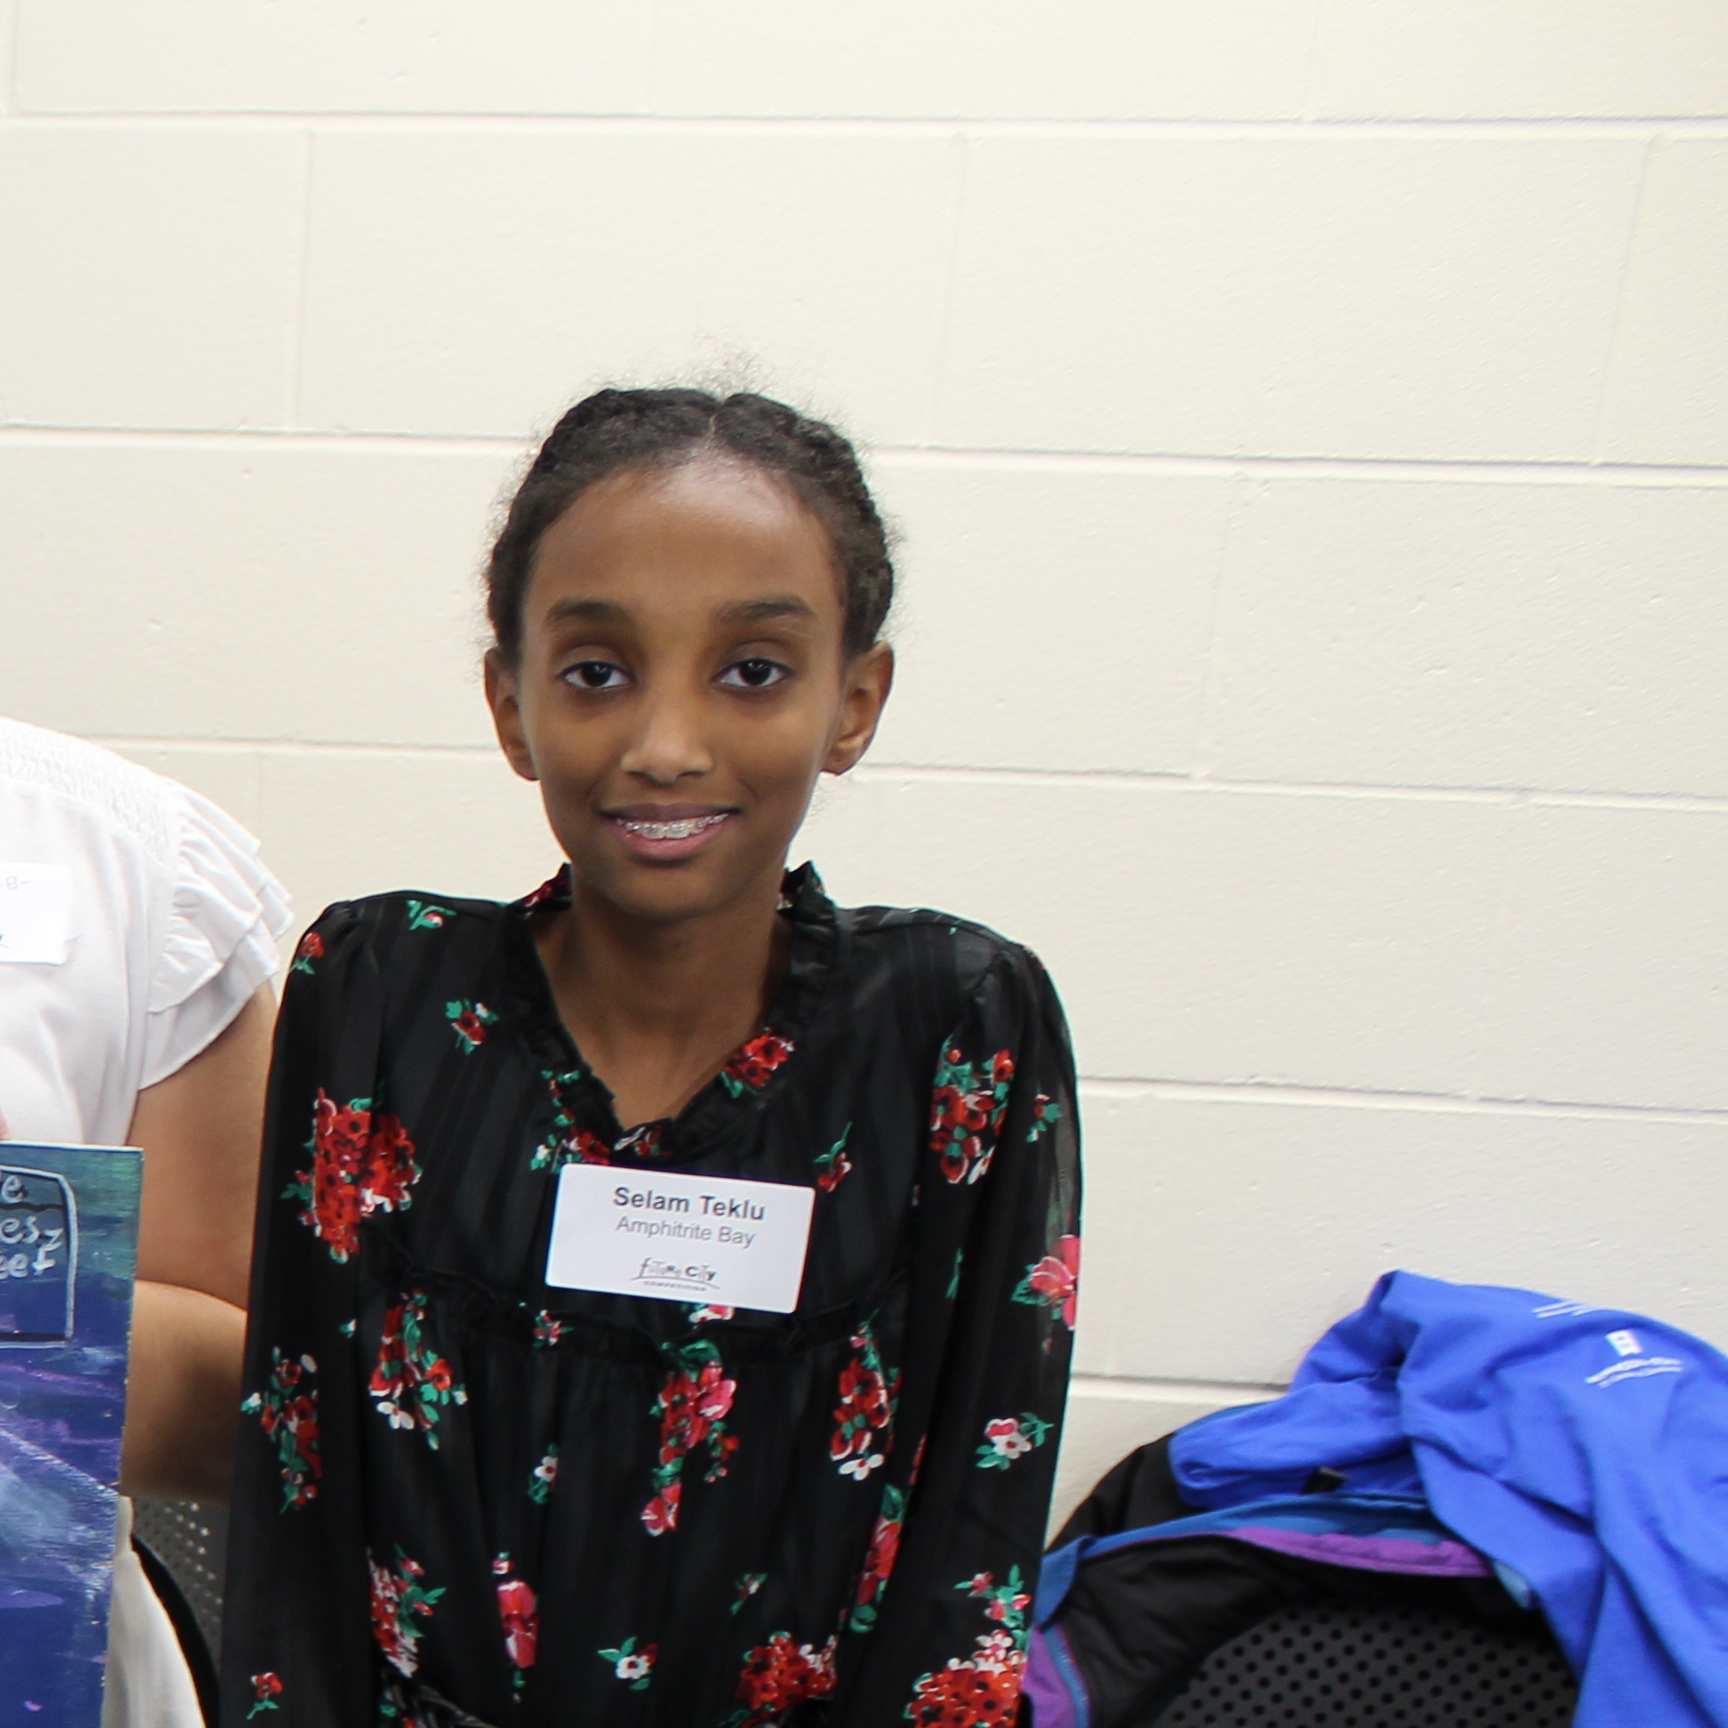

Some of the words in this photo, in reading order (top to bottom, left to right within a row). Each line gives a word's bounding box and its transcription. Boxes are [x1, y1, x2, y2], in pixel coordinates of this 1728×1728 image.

[613, 1186, 690, 1214] Selam
[700, 1195, 766, 1221] Teklu
[615, 1215, 712, 1241] Amphitrite
[718, 1225, 756, 1250] Bay
